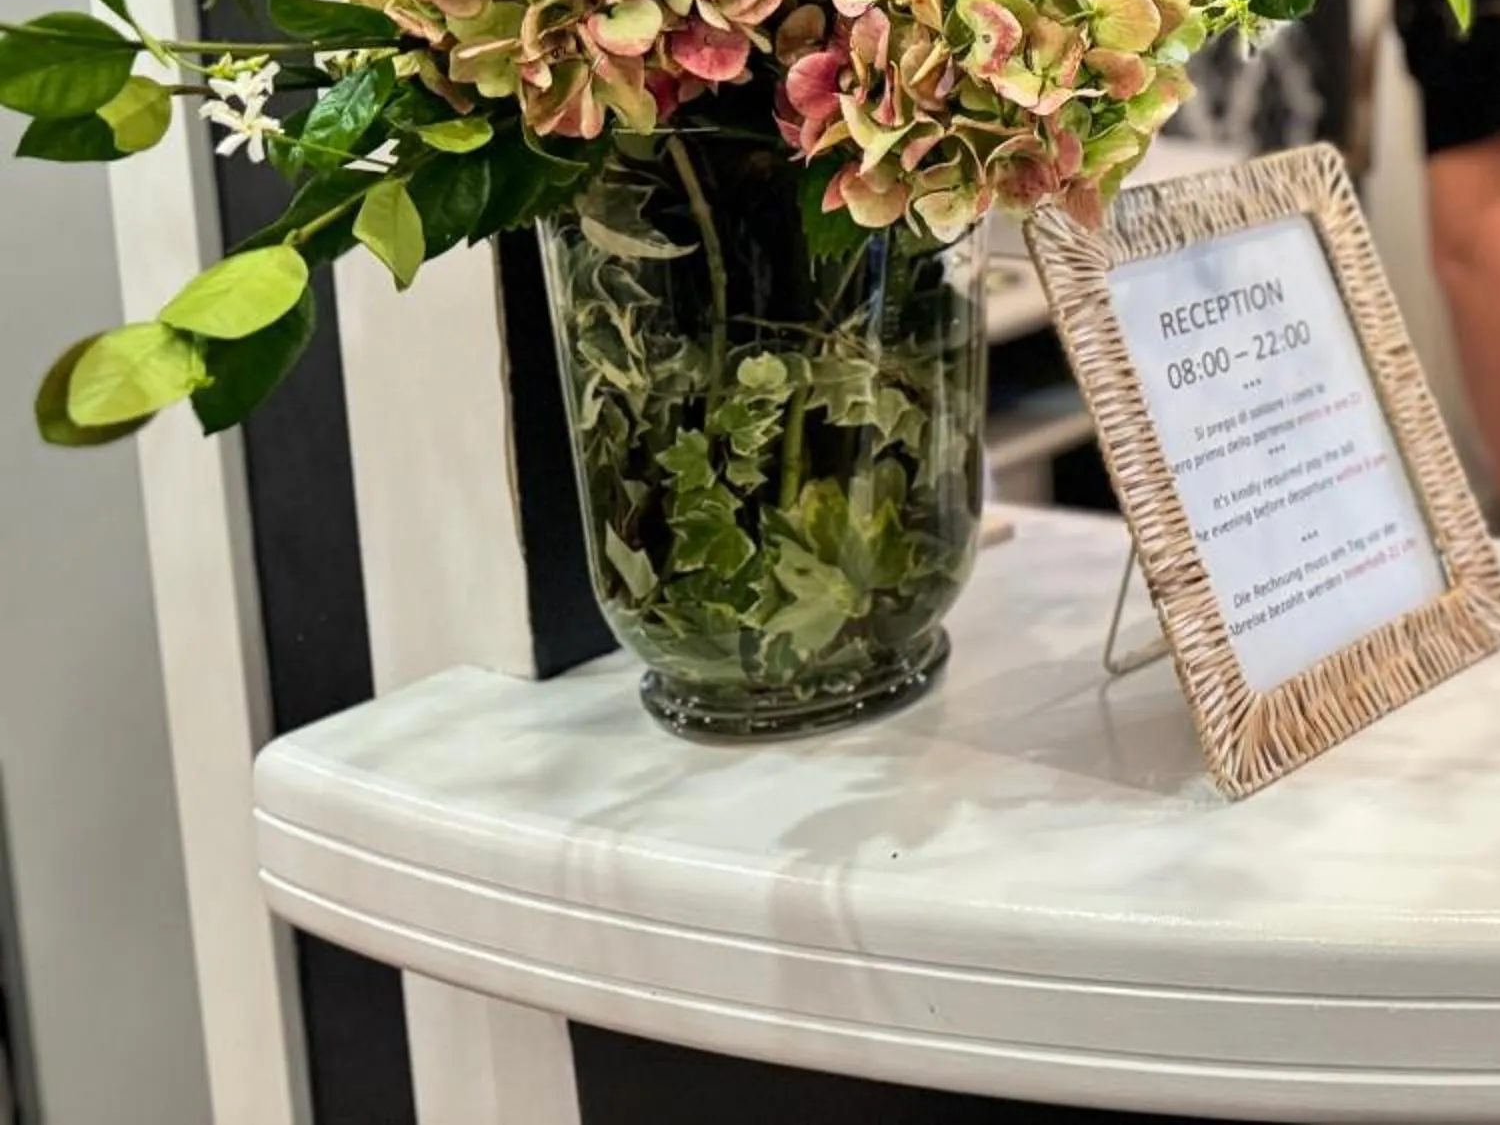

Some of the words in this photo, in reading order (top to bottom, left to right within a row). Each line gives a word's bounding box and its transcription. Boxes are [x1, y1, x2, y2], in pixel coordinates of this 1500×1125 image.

[1159, 277, 1285, 340] RECEPTION
[1166, 346, 1231, 390] 08:00
[1252, 319, 1312, 361] 22:00
[1193, 445, 1226, 471] prima
[1211, 511, 1253, 539] evening
[1253, 496, 1286, 520] before
[1233, 590, 1252, 609] Die
[1252, 565, 1304, 599] Rechnung
[1266, 590, 1306, 619] bezahlt
